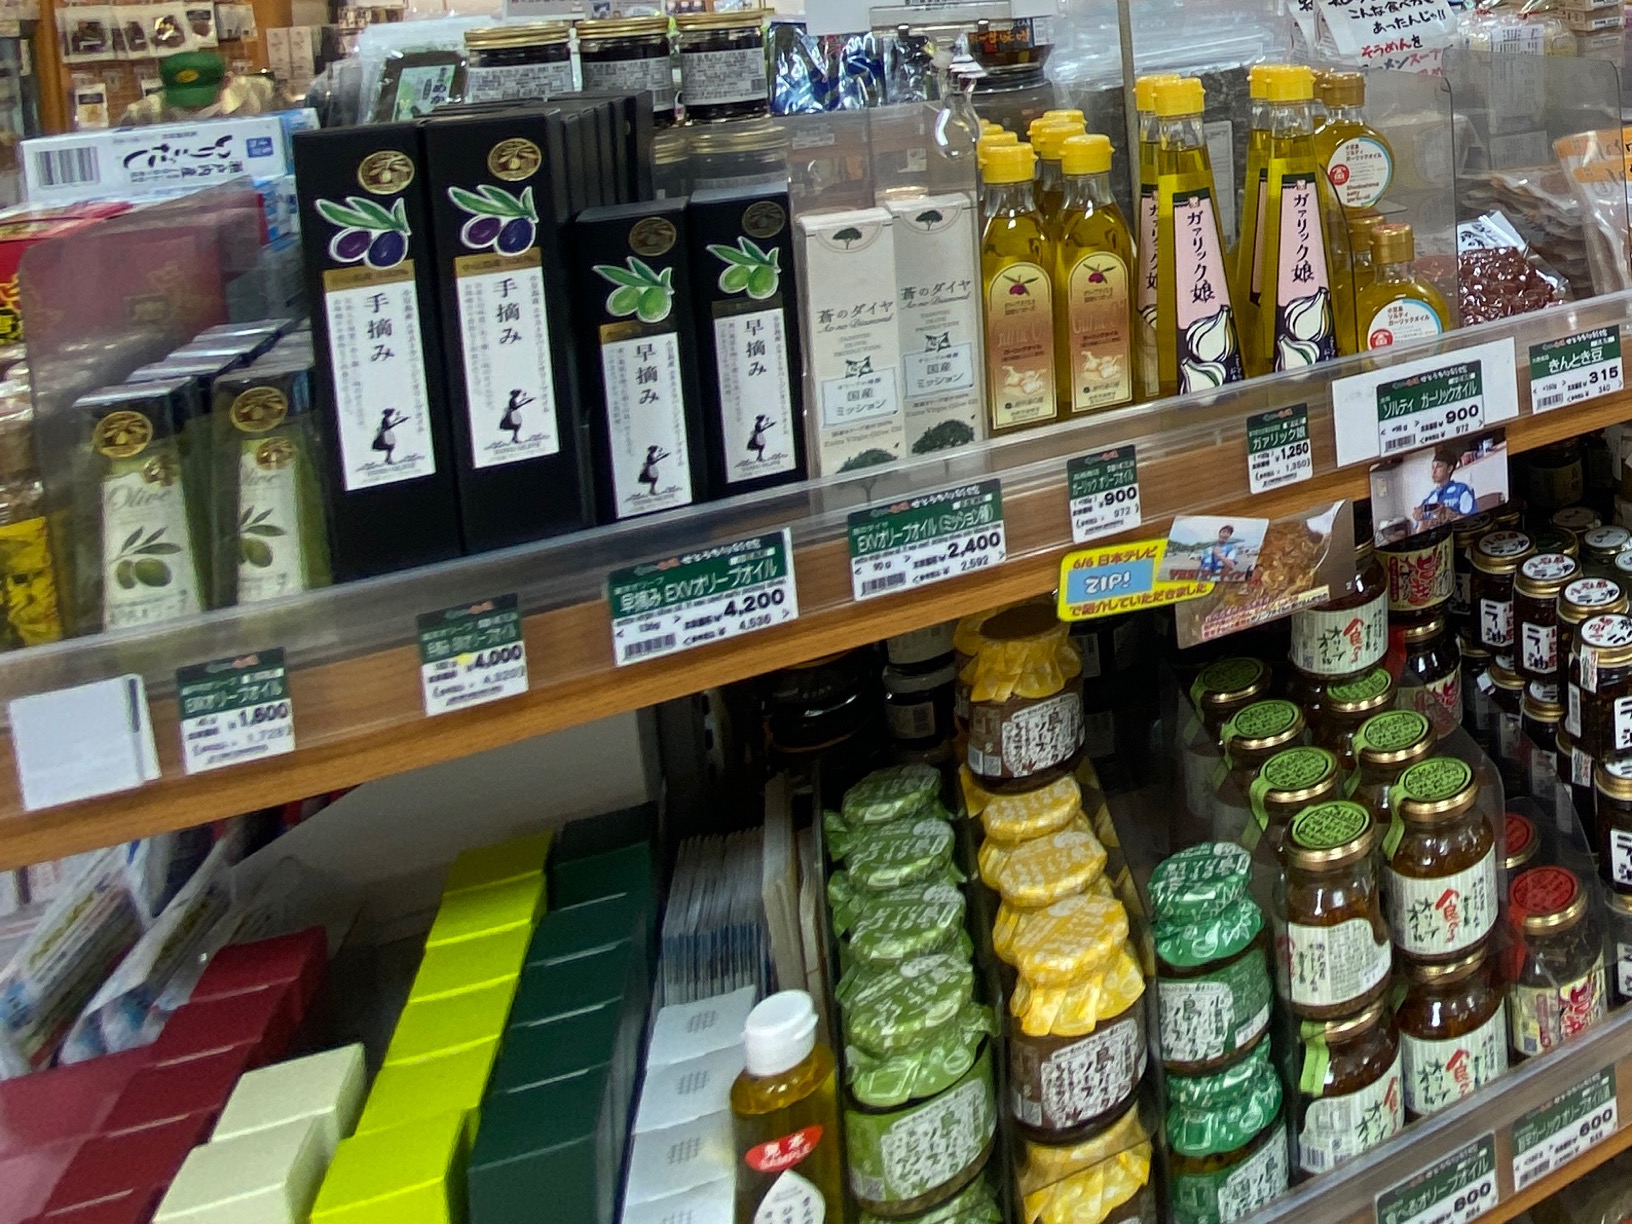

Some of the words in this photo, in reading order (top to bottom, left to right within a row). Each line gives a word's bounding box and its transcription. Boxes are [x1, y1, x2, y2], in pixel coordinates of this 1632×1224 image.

[1361, 35, 1423, 58] そうめんを
[901, 279, 972, 302] 蒼のダイヤ
[492, 277, 522, 345] 手摘み
[817, 301, 894, 325] 蒼のダイヤ
[364, 292, 396, 363] 手摘み
[746, 318, 767, 377] 早摘み
[1549, 347, 1604, 373] きんとき豆
[635, 342, 660, 406] 早摘み
[916, 373, 964, 389] ミッション
[1589, 366, 1619, 385] 315
[836, 399, 886, 416] ミッション
[1383, 398, 1413, 419] ソルティ
[1421, 384, 1477, 409] ガーリックオイル
[1445, 404, 1480, 426] 900
[1280, 442, 1309, 462] 1,250
[1104, 486, 1137, 506] 900
[948, 531, 1000, 559] 2,400
[1074, 557, 1093, 569] 6/6
[1098, 546, 1157, 565] 日本テレビ
[620, 589, 662, 614] 早摘み
[664, 560, 778, 603] EXVオリーブオイル
[1086, 572, 1131, 595] ZIP!
[724, 588, 785, 618] 4,200
[1070, 583, 1211, 615] で紹介していただきました
[474, 644, 523, 671] 4,000
[1579, 1107, 1613, 1137] 600
[1454, 1180, 1491, 1213] 800
